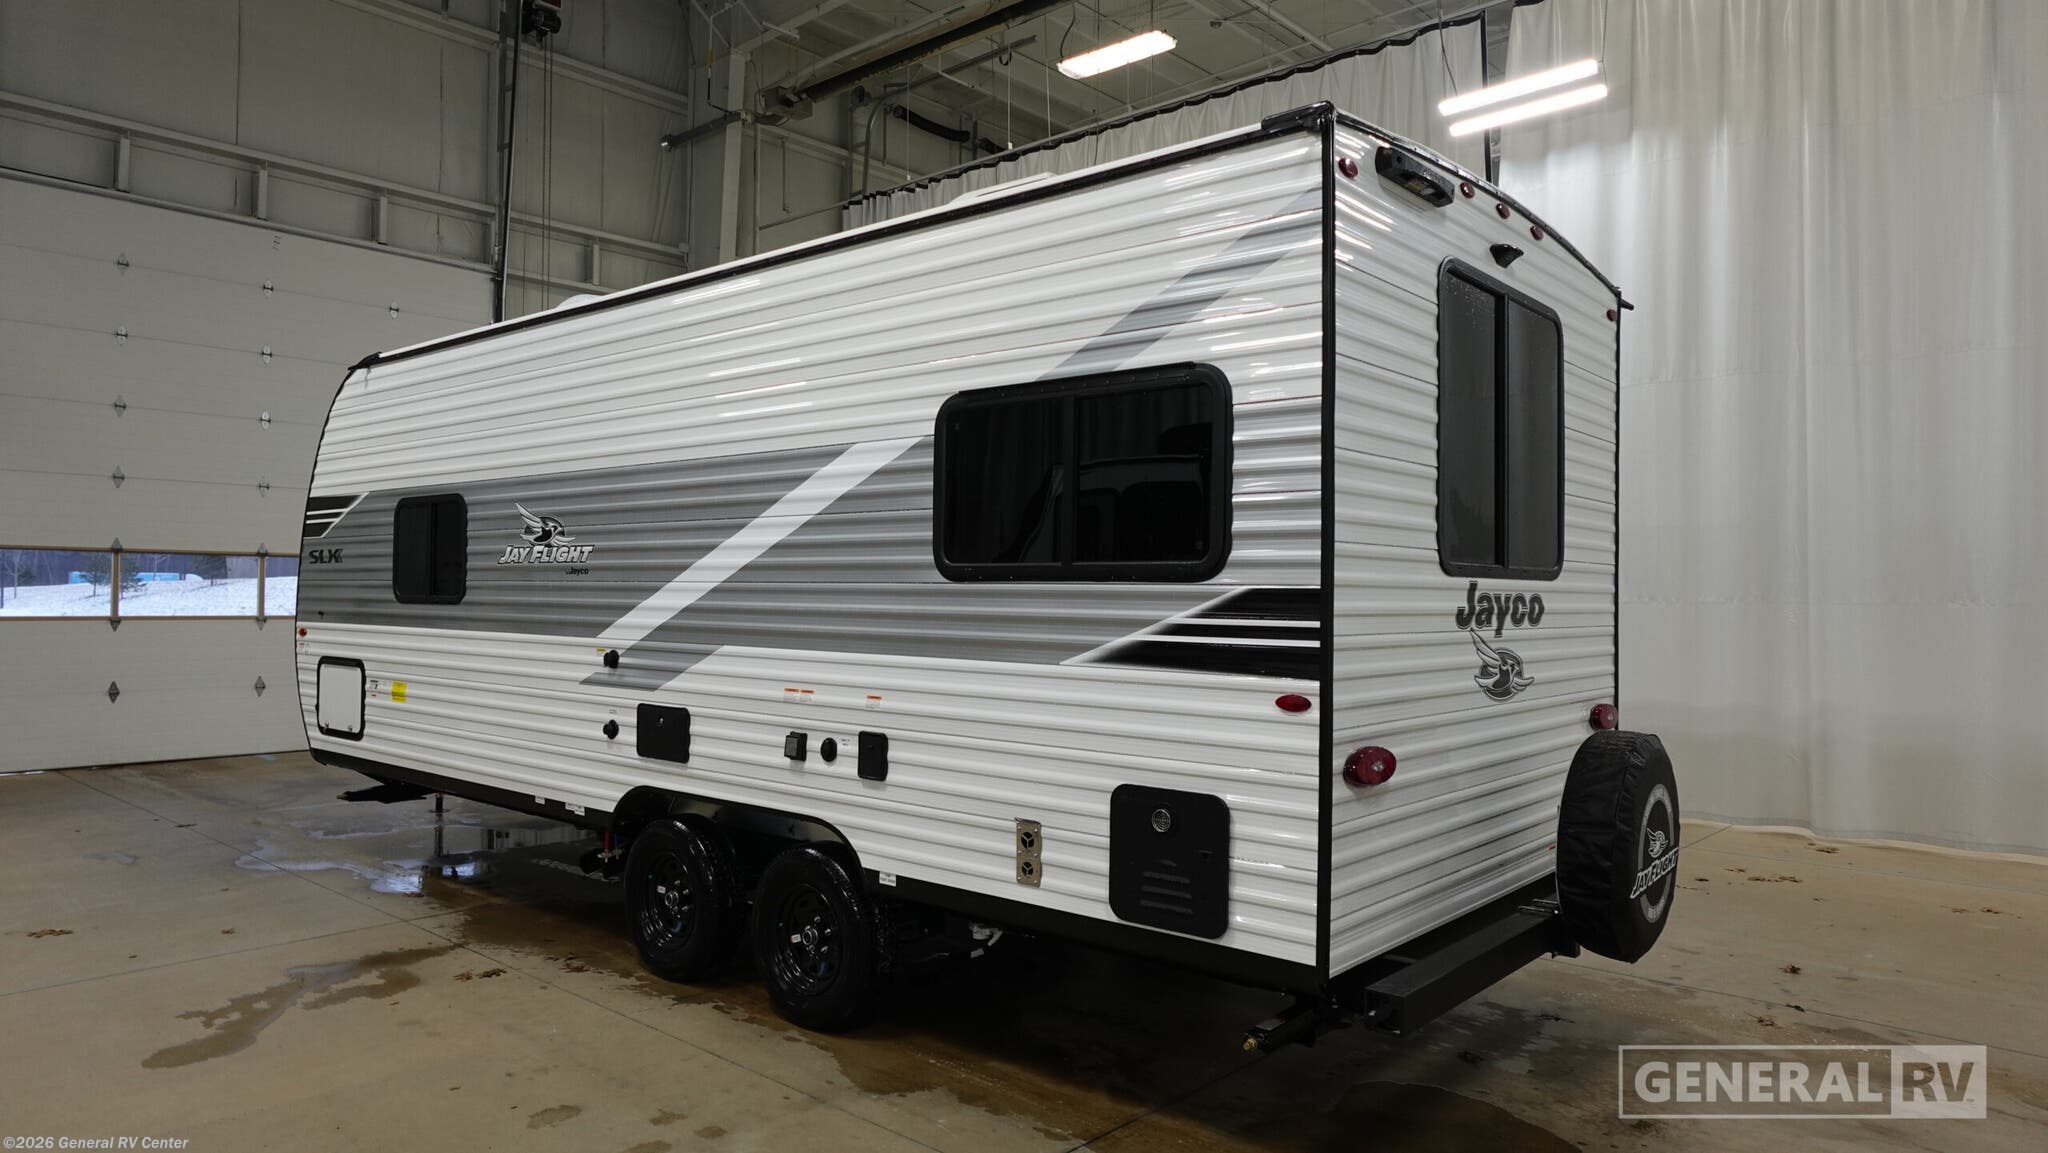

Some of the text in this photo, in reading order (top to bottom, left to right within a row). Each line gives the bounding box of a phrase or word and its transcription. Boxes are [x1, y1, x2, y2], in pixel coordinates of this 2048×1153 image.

[309, 548, 343, 564] SLK
[498, 544, 595, 564] JAY FLIGHT
[1455, 580, 1545, 638] Jayco
